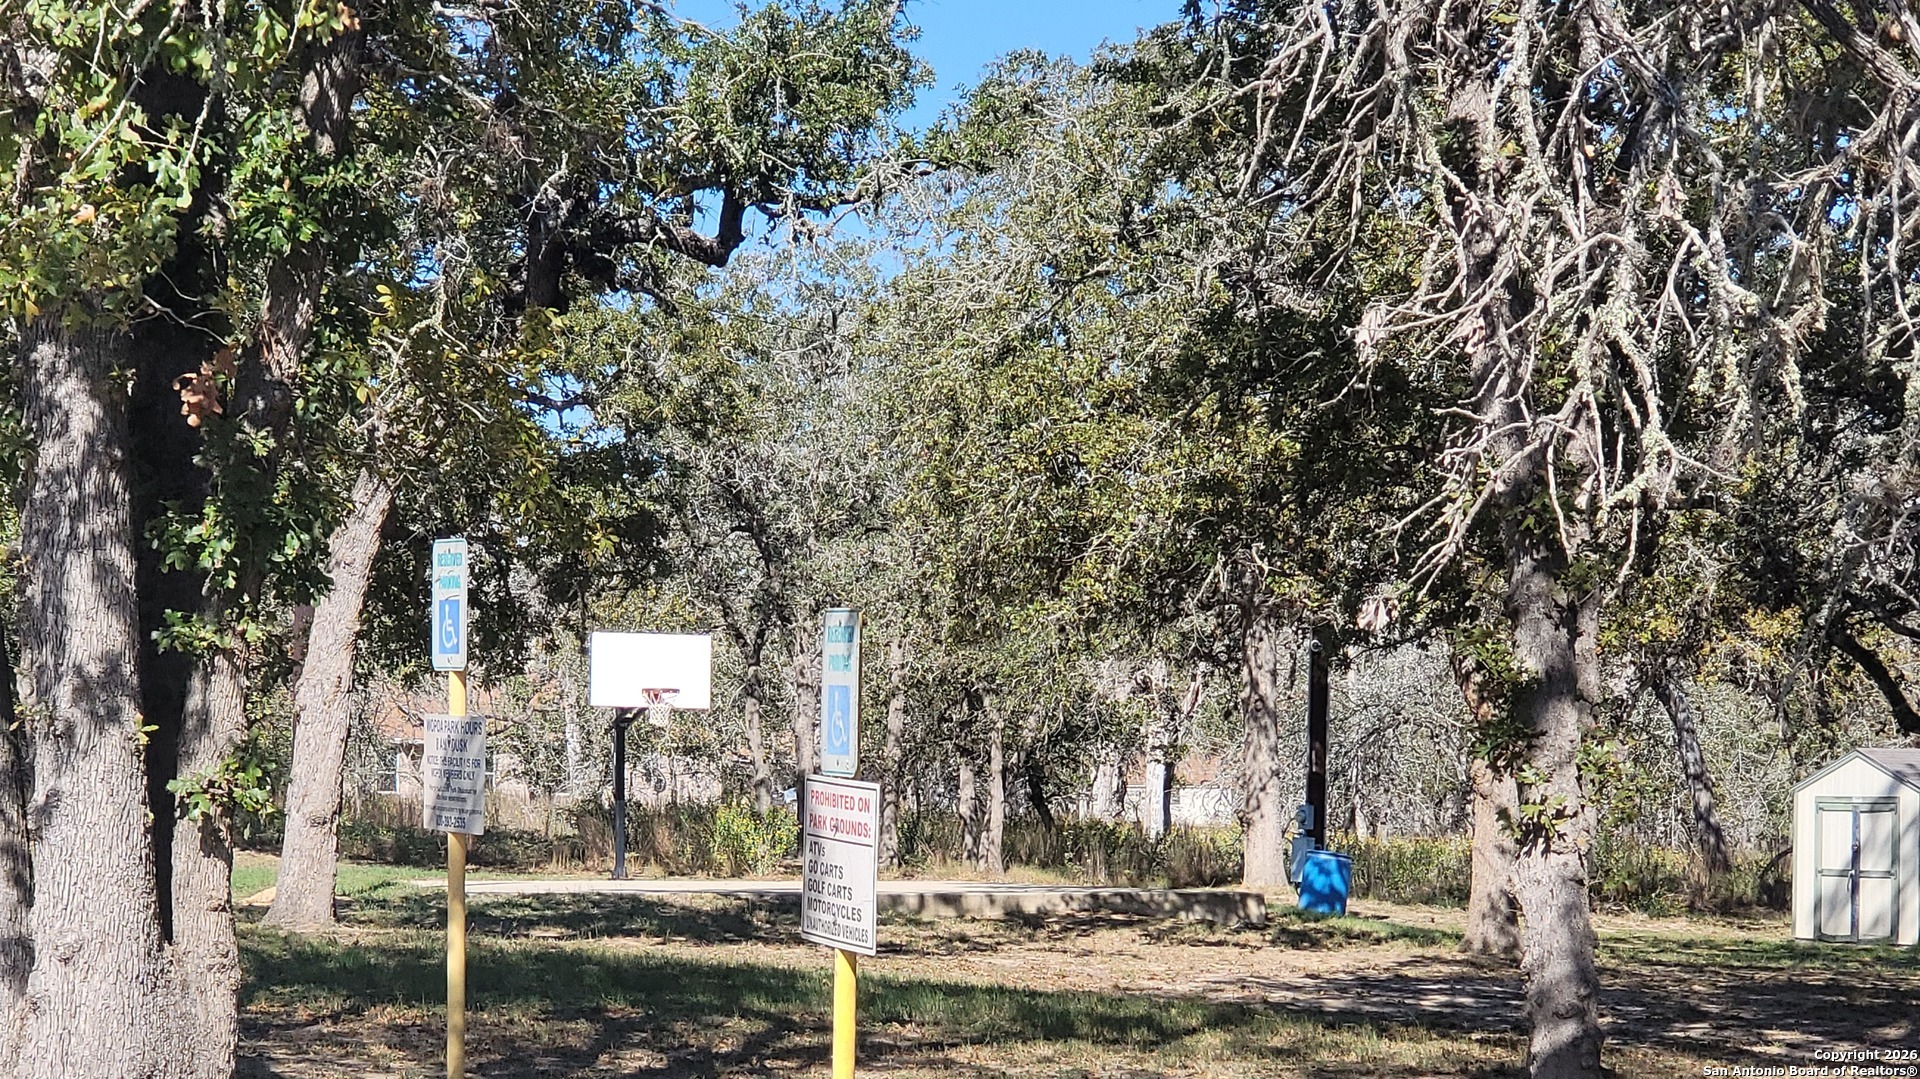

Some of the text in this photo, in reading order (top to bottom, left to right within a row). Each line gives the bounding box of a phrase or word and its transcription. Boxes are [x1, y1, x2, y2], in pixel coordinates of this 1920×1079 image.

[444, 719, 460, 735] PARK
[461, 720, 482, 735] HOURS
[452, 738, 468, 752] DUSK
[810, 789, 870, 813] PROHIBITED ON
[809, 813, 827, 831] PARK
[808, 841, 826, 857] ATVs
[808, 859, 844, 880] GO CARTS
[807, 878, 852, 901] GOLF CARTS
[807, 896, 862, 923] MOTORCYCLES
[806, 915, 869, 943] UNAUTHORIZED VEHICLES
